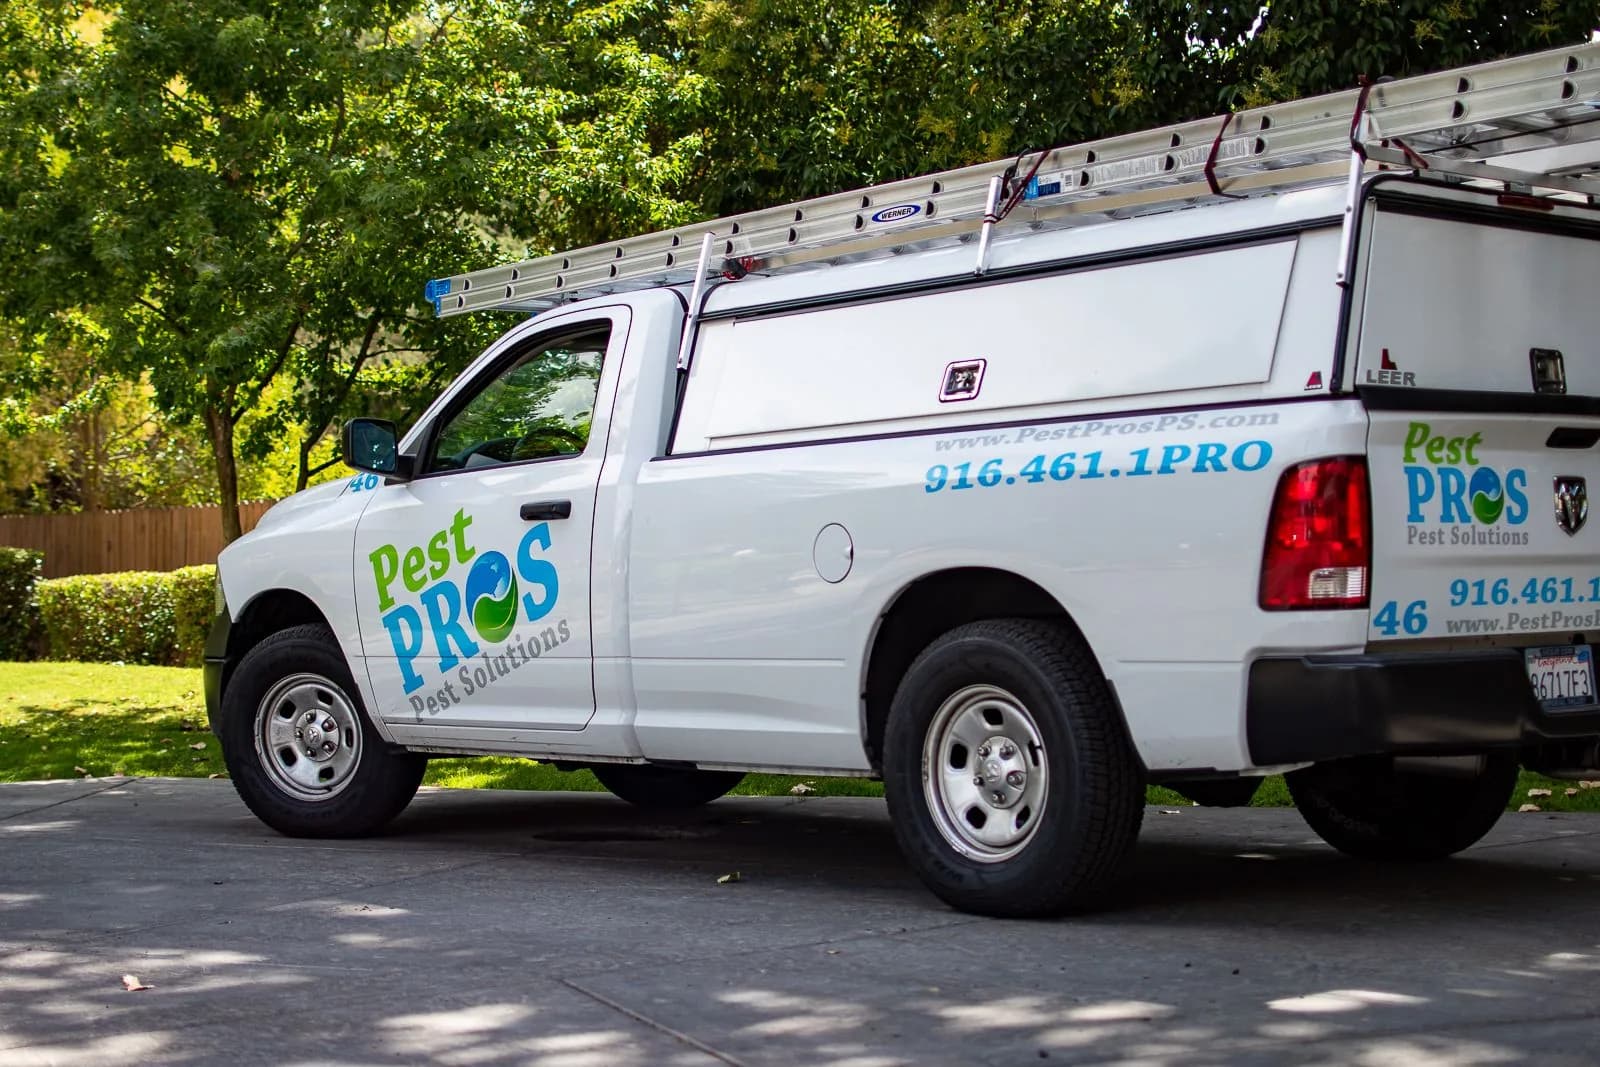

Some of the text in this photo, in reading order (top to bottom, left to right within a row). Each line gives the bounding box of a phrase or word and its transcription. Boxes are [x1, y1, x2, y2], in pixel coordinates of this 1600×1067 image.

[881, 207, 912, 220] WERNER
[1366, 369, 1416, 387] LEER
[935, 410, 1280, 453] www.PestProsPS.com
[1403, 422, 1483, 466] Pest
[350, 471, 379, 493] 46
[925, 439, 1274, 494] 916.461.1PRO
[1403, 466, 1529, 525] PROS
[1407, 525, 1529, 546] Pest Solutions
[369, 507, 476, 613] Pest
[382, 522, 559, 695] PROS
[1373, 600, 1428, 636] 46
[409, 618, 571, 723] Pest Solutions
